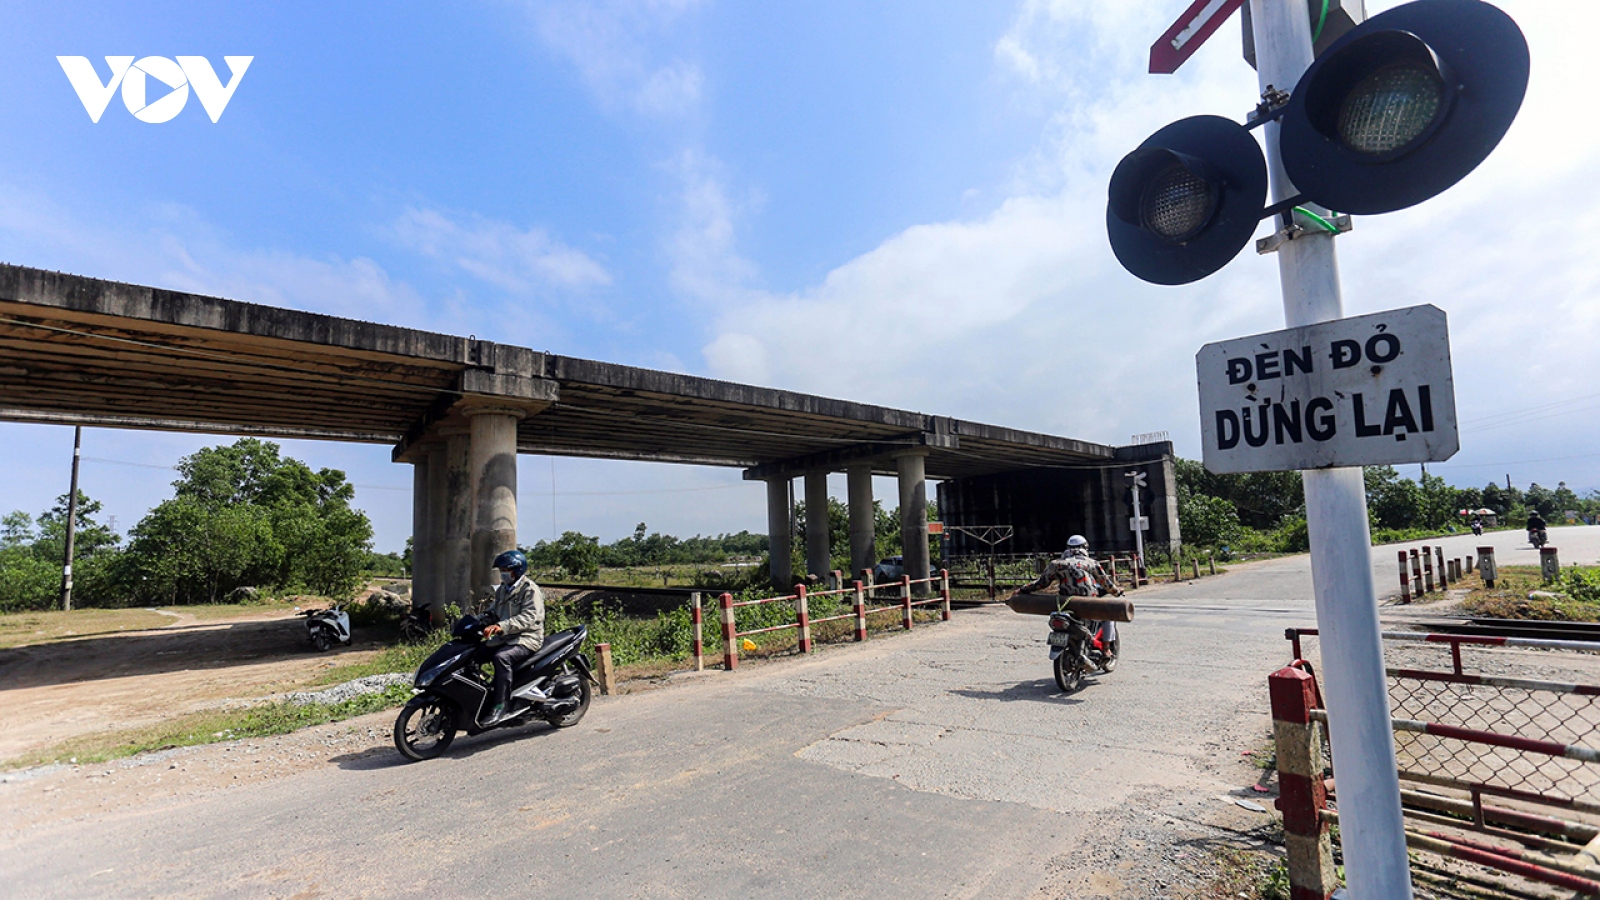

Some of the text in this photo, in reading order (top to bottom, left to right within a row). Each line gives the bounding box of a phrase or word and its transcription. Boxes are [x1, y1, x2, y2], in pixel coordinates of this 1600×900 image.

[1225, 323, 1404, 386] ĐÈN ĐỎ
[1215, 384, 1435, 451] DỪNG LẠI
